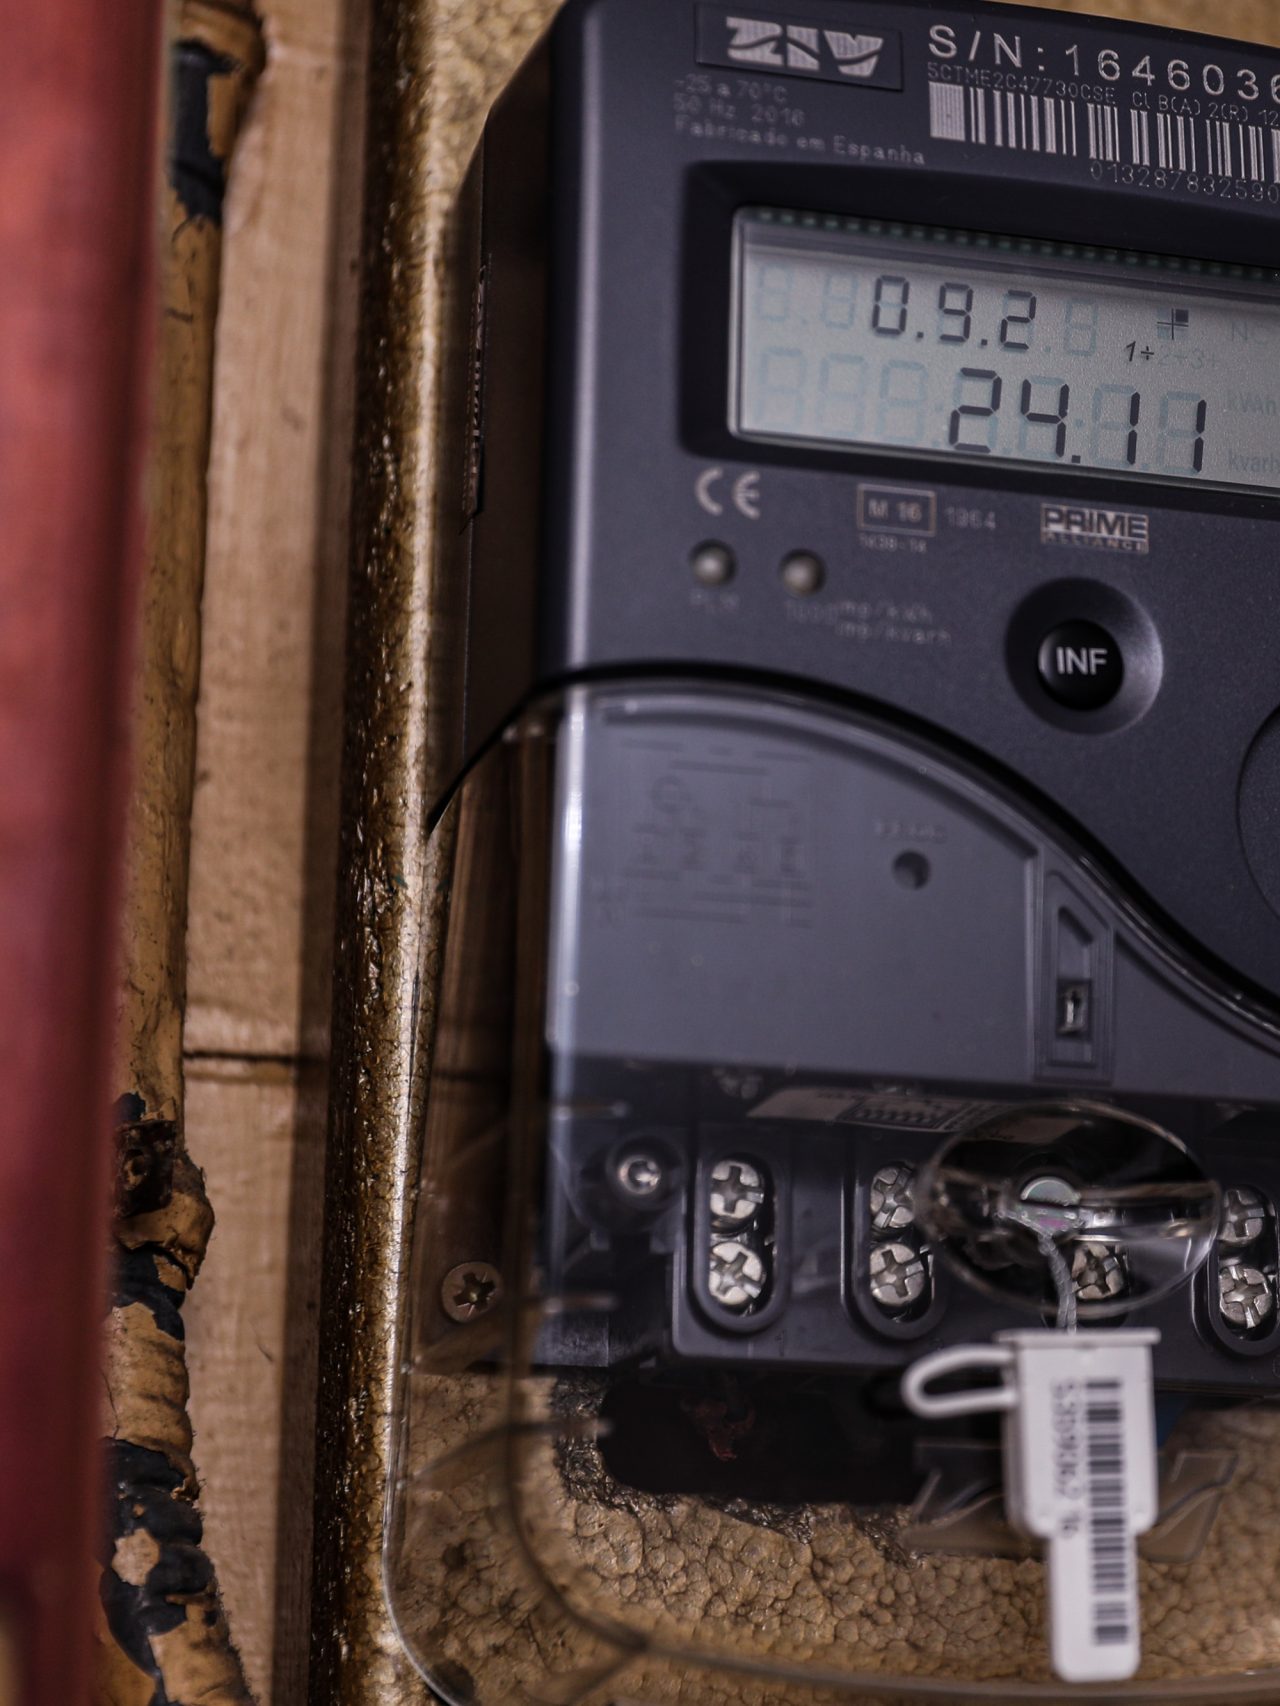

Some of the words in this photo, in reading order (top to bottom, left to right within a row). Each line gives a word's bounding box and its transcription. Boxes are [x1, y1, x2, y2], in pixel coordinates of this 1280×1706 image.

[1158, 94, 1200, 115] B(A)
[1208, 102, 1249, 122] 2(R)
[833, 135, 925, 166] Espanha
[872, 275, 1037, 350] 0.9.2
[948, 367, 1206, 473] 24.11
[868, 497, 889, 519] M
[897, 502, 922, 524] 16
[1045, 508, 1147, 539] PRIME
[1056, 646, 1107, 677] INF
